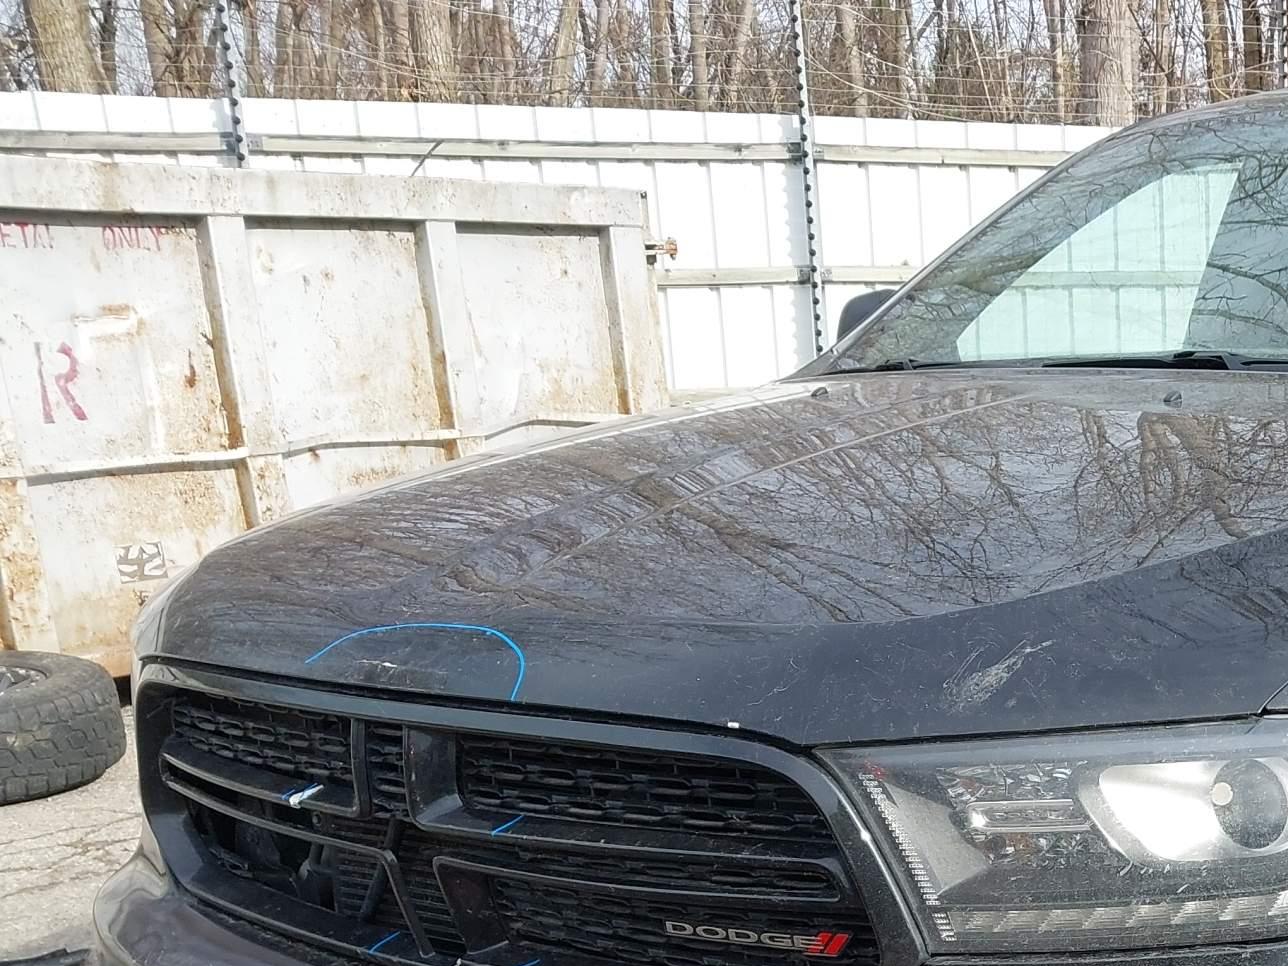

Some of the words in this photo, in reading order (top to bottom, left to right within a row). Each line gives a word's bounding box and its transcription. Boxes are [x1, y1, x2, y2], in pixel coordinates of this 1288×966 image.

[102, 224, 162, 251] ONLY
[34, 342, 88, 424] R
[664, 921, 825, 950] DODGE
